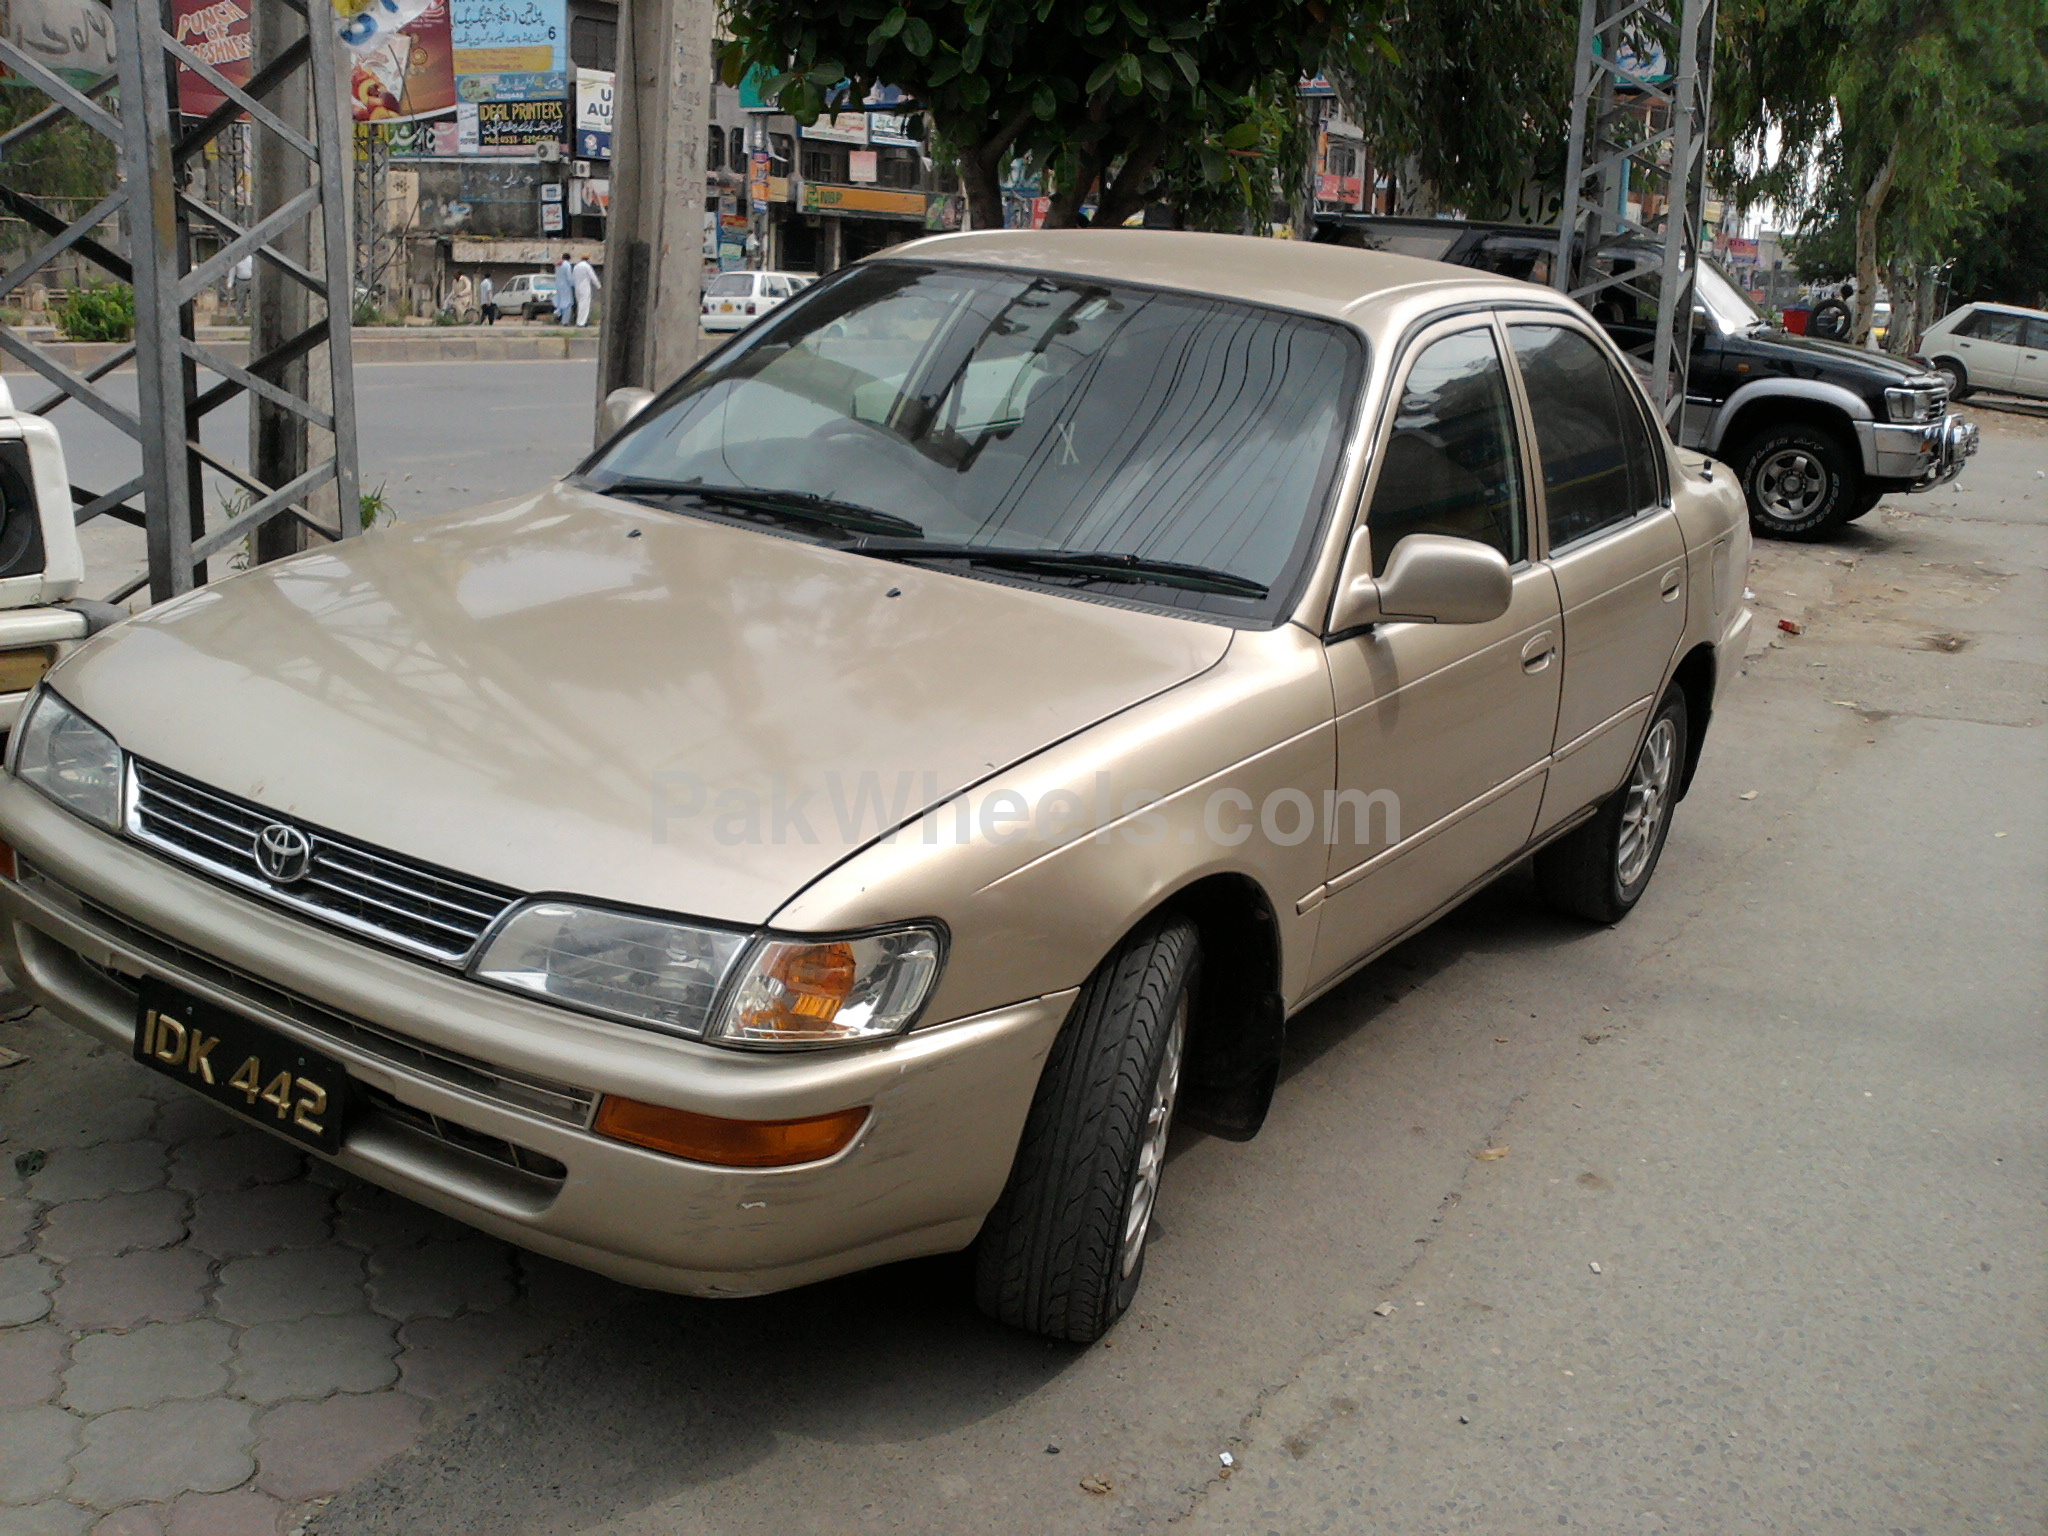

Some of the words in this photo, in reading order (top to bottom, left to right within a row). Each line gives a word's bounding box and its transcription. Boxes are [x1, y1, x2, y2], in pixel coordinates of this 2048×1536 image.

[177, 0, 248, 41] PUNCH
[206, 24, 229, 41] OF
[548, 27, 556, 40] 6
[512, 102, 563, 120] PRINTERS
[820, 191, 843, 204] NBP
[143, 1008, 221, 1085] IDK
[228, 1055, 328, 1136] 442
